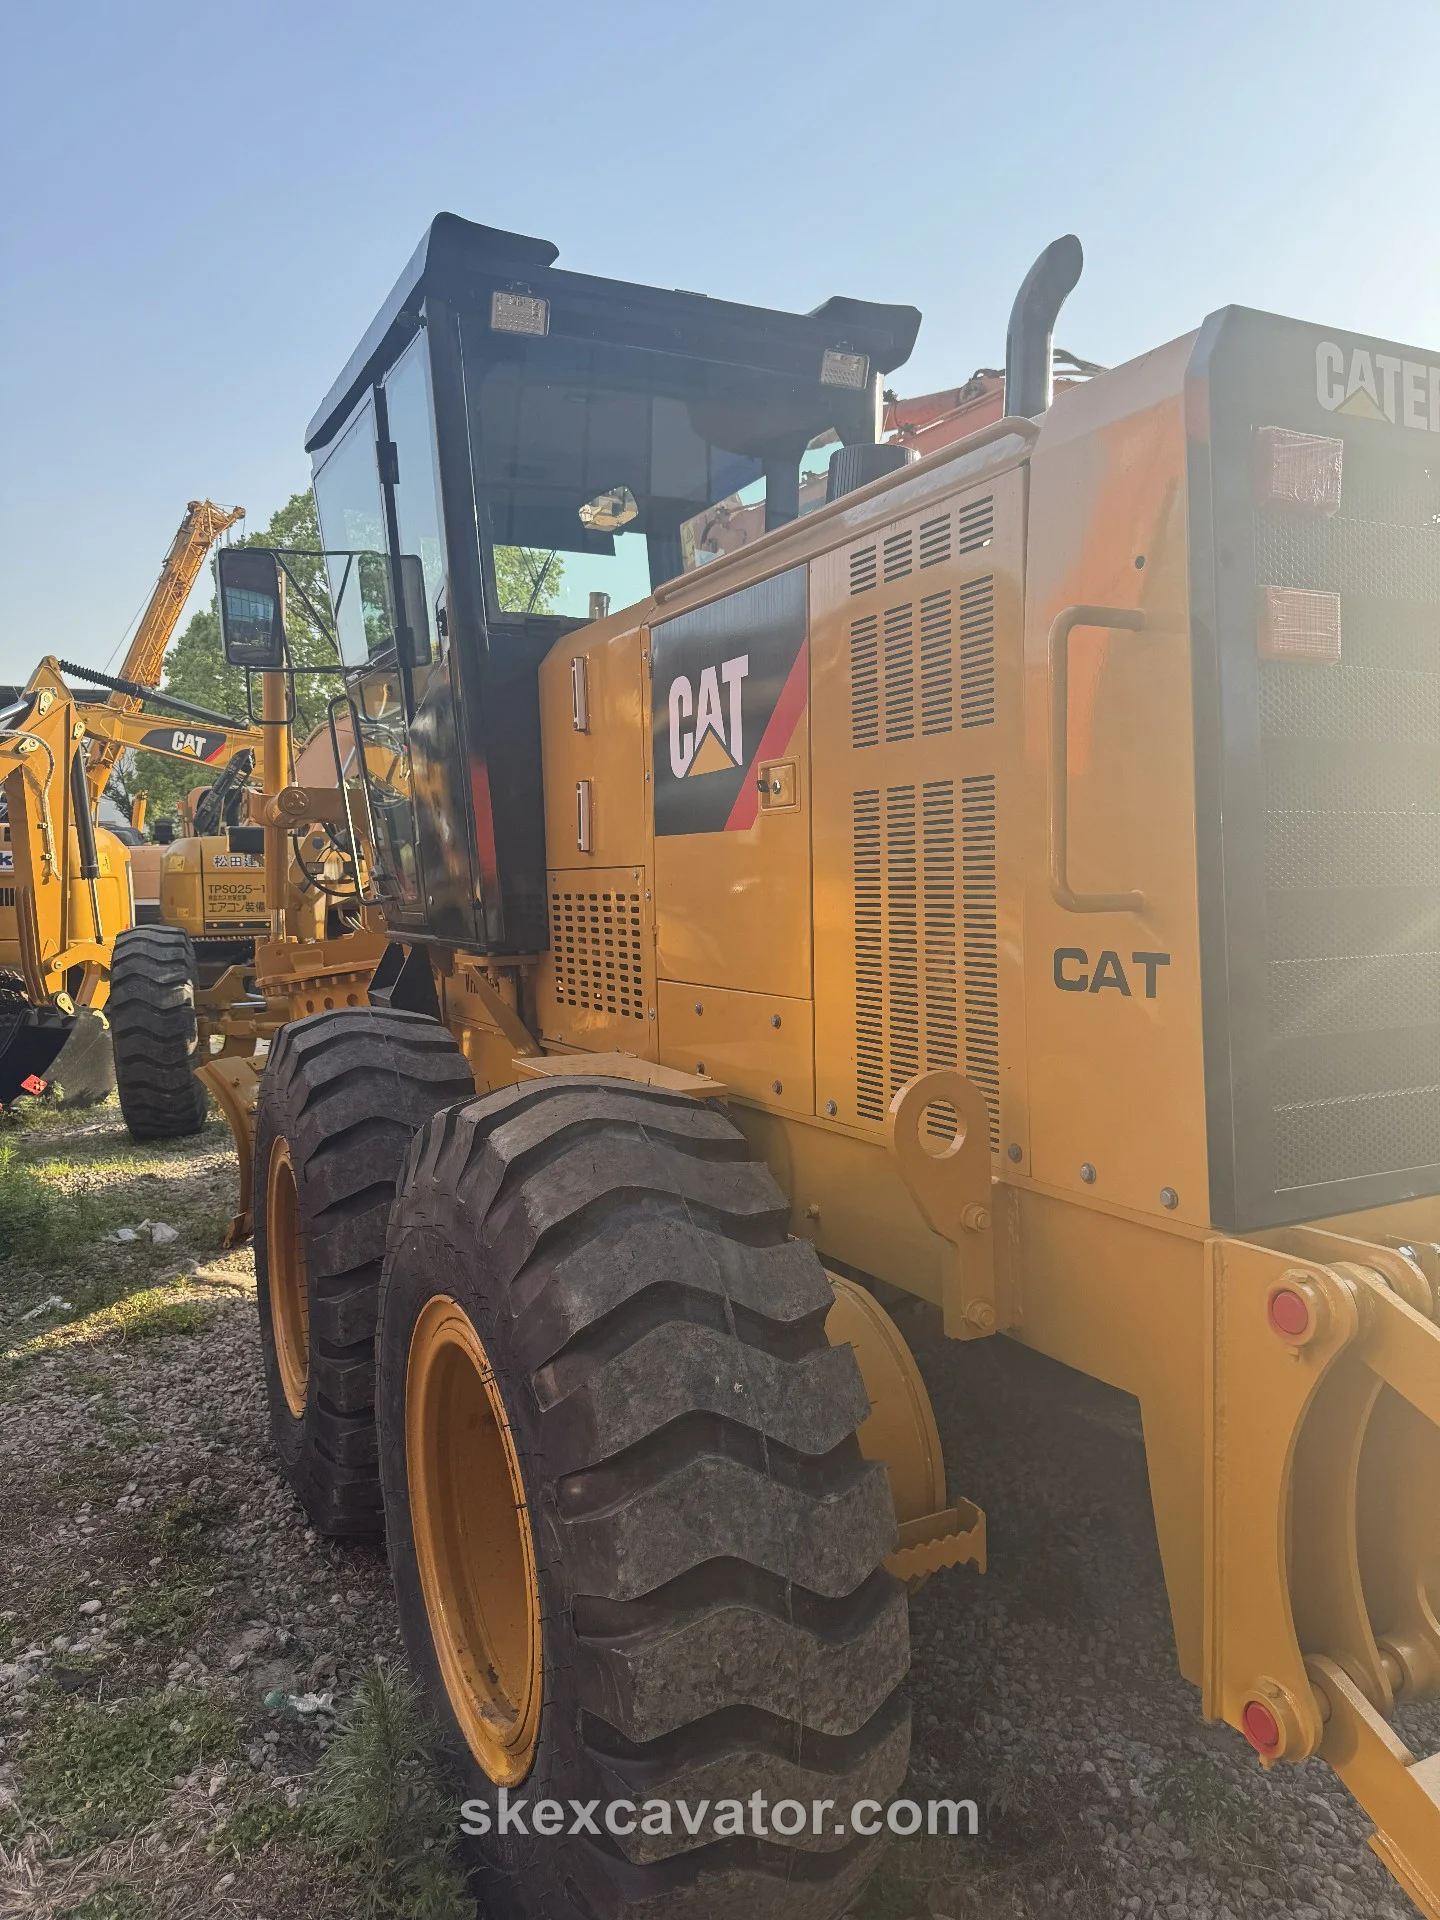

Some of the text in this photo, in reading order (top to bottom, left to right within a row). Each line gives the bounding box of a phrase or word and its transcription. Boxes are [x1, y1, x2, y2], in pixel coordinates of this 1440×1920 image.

[669, 654, 749, 778] CAT
[172, 731, 206, 757] CAT
[1054, 948, 1170, 998] CAT
